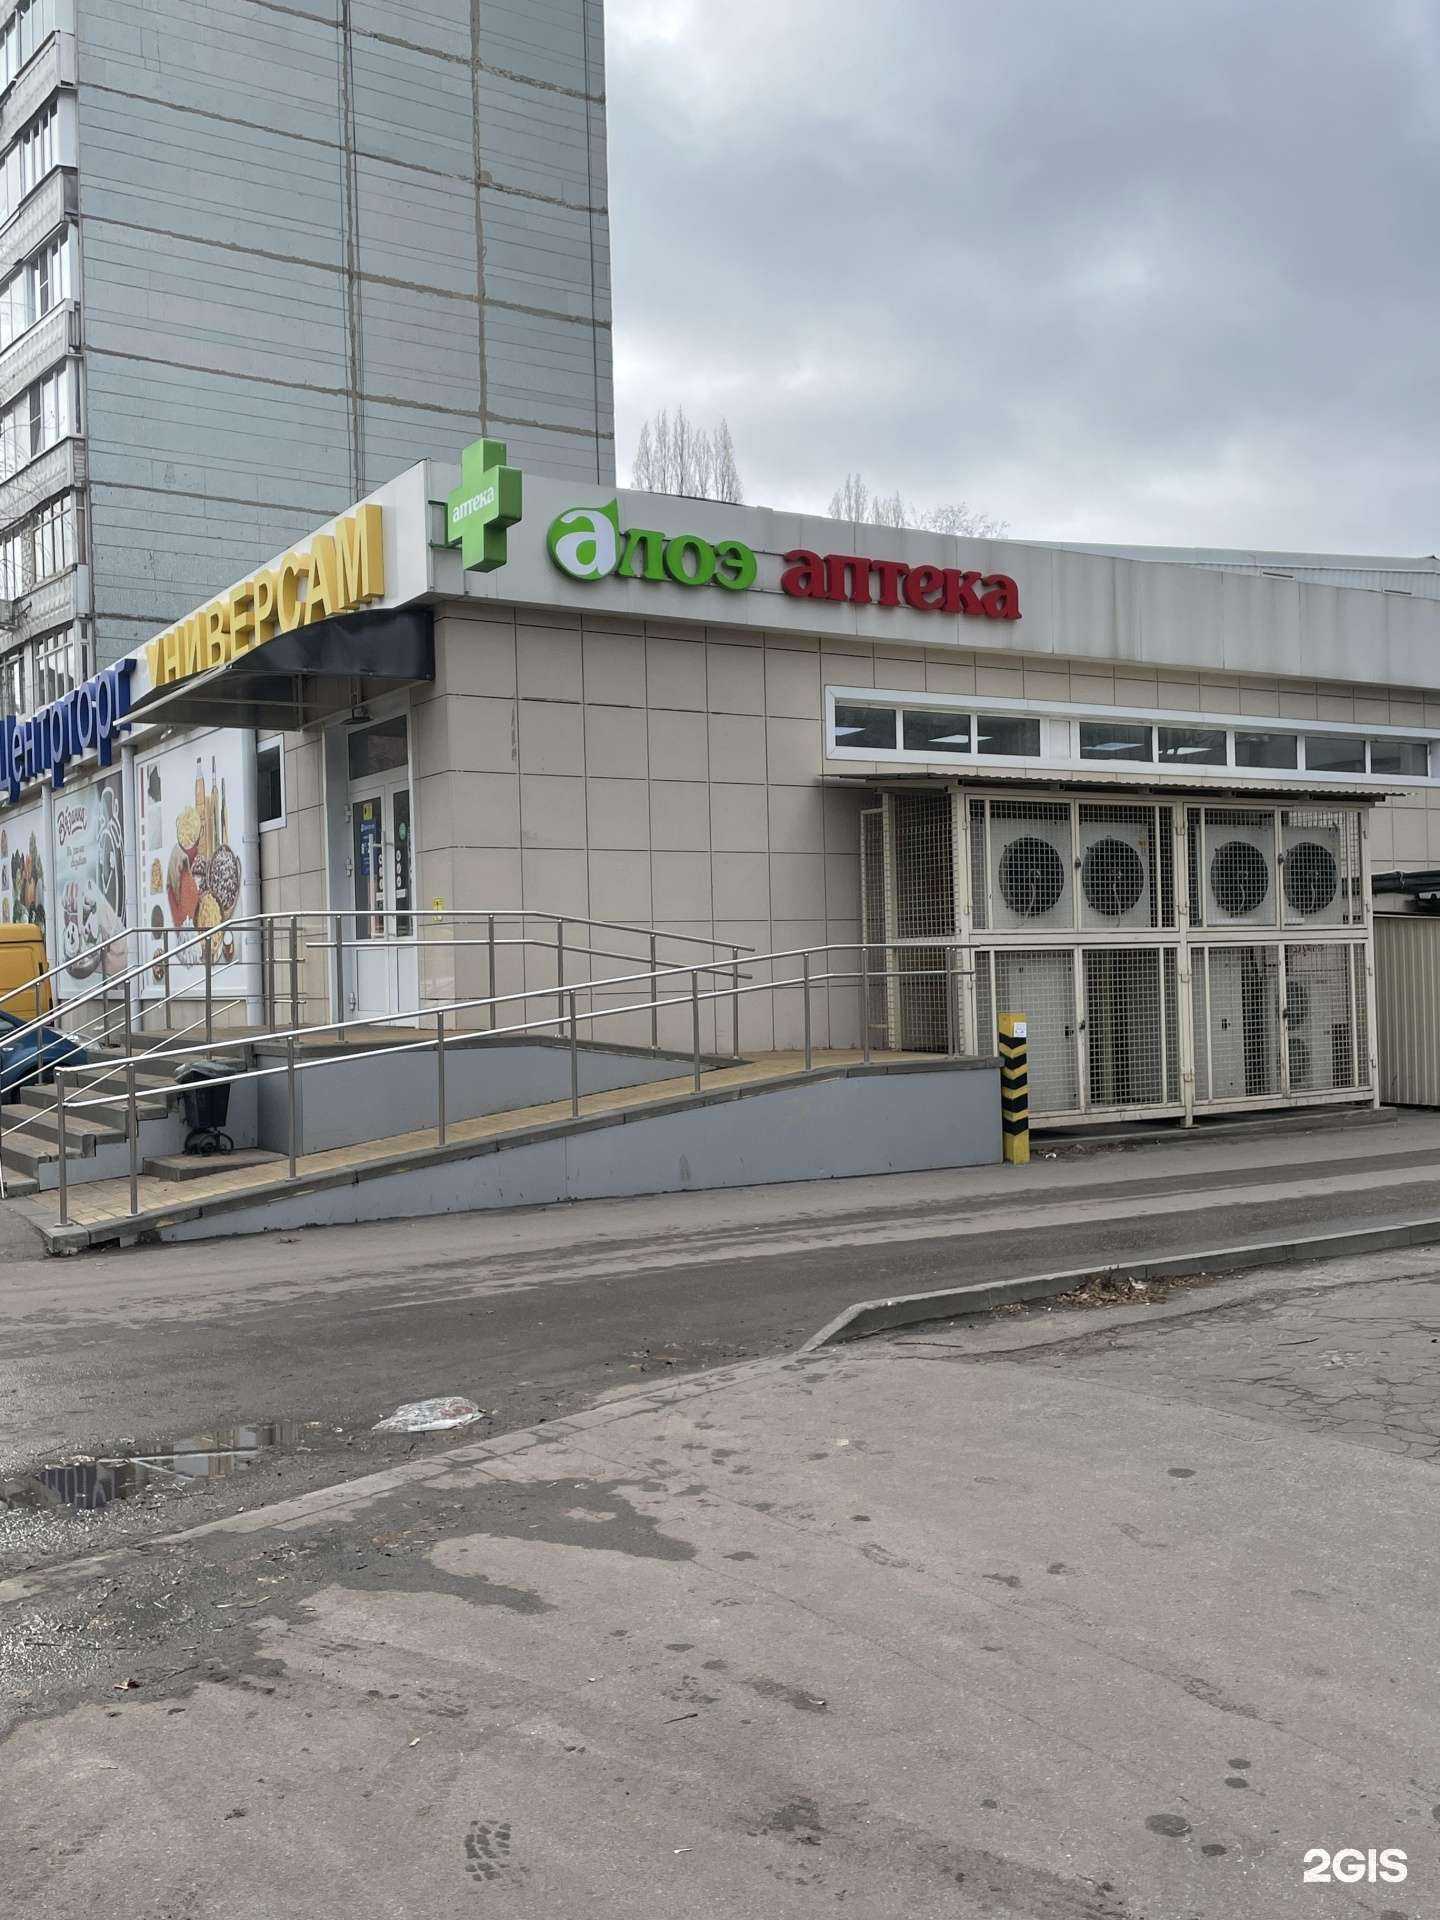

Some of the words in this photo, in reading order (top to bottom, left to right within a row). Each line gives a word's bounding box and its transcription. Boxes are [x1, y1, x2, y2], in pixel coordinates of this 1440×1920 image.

[453, 487, 495, 522] аптека
[147, 504, 384, 687] УНИВЕРСАМ
[781, 549, 1022, 619] аптека
